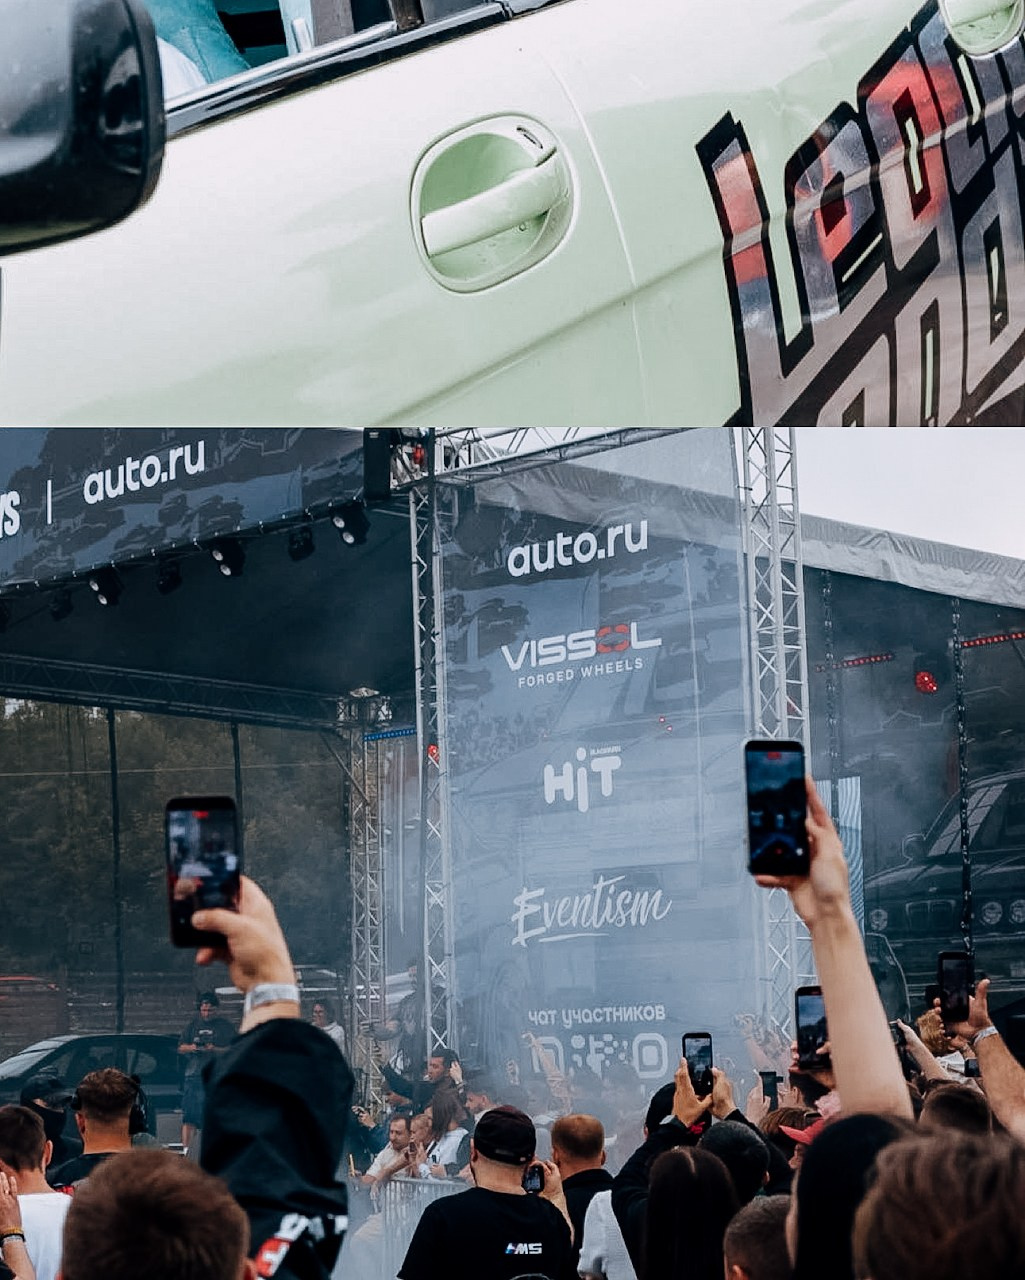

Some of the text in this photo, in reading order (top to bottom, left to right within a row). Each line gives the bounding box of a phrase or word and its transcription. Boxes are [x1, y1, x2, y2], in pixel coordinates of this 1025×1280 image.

[83, 440, 205, 505] auto.ru
[507, 520, 648, 578] auto.ru
[518, 658, 644, 689] FORGED WHEELS
[511, 875, 674, 948] Eventism
[528, 1004, 666, 1029] чат участников
